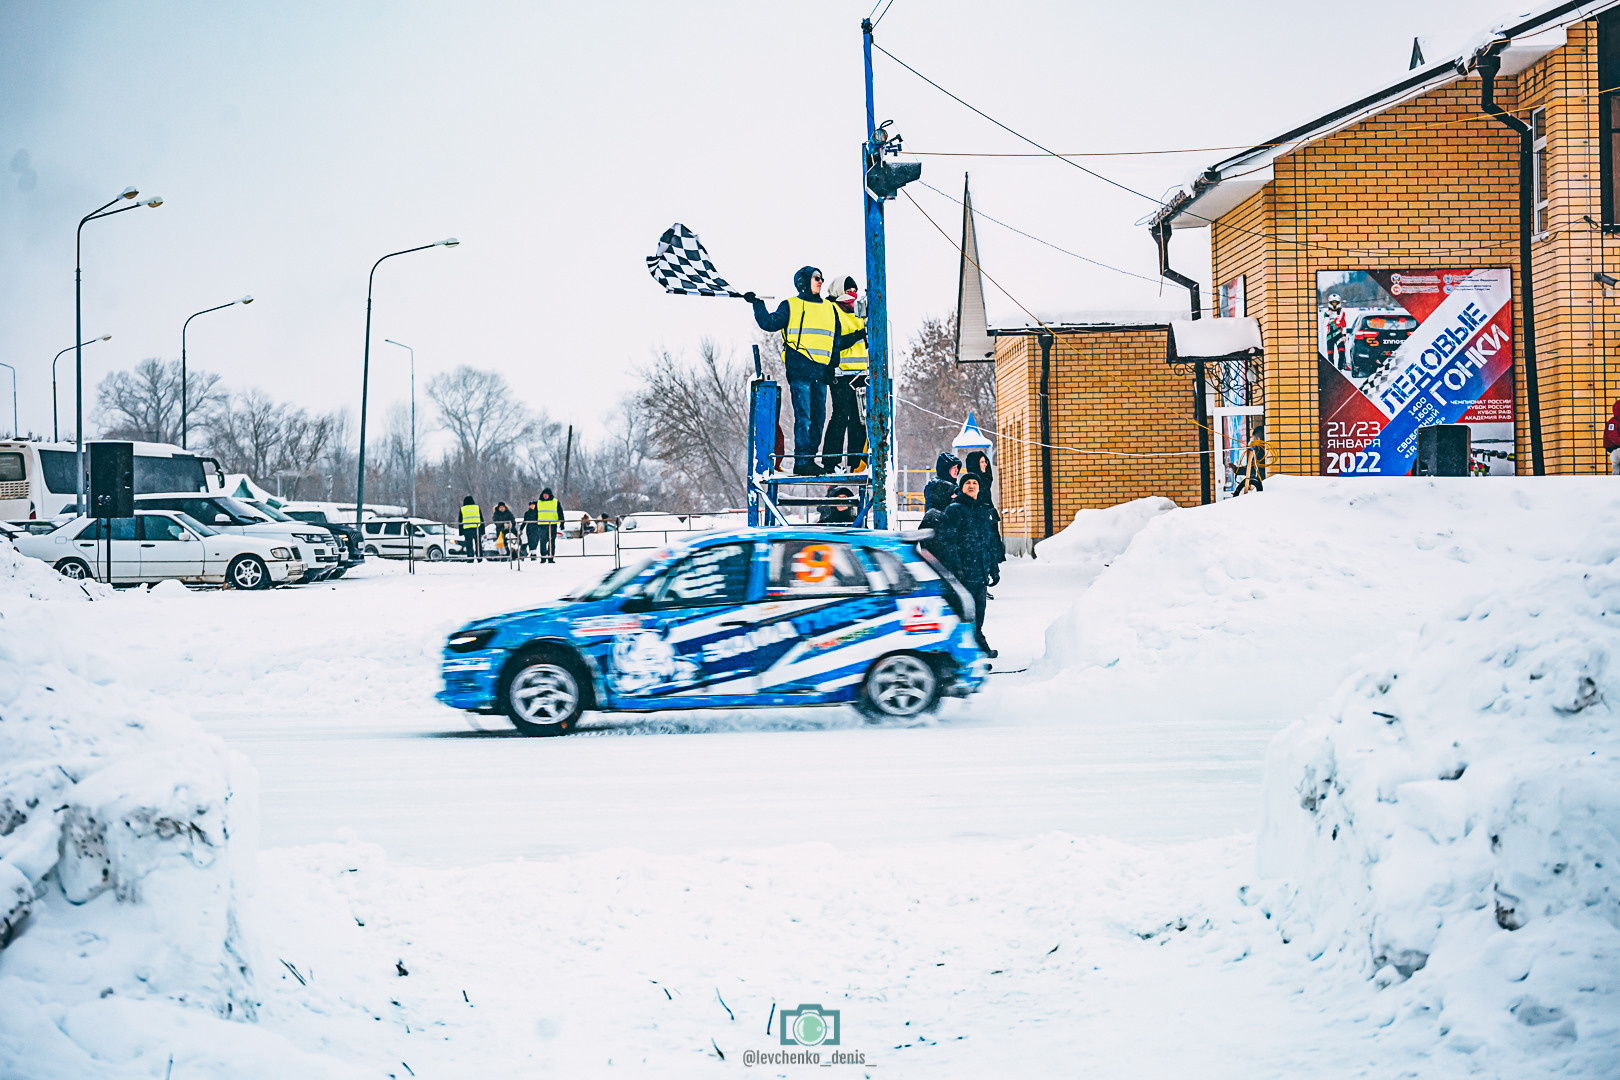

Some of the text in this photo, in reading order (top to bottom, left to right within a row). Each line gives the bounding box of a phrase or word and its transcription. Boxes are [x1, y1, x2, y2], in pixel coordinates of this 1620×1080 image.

[1379, 302, 1487, 414] ЛЕДОВЫЕ
[1428, 323, 1510, 407] ГОНКИ
[1408, 397, 1427, 416] 1400
[1414, 403, 1434, 422] 1600
[1327, 421, 1381, 437] 21/23
[1327, 438, 1381, 449] ЯНВАРЯ
[1326, 451, 1381, 474] 2022
[790, 544, 834, 583] 9
